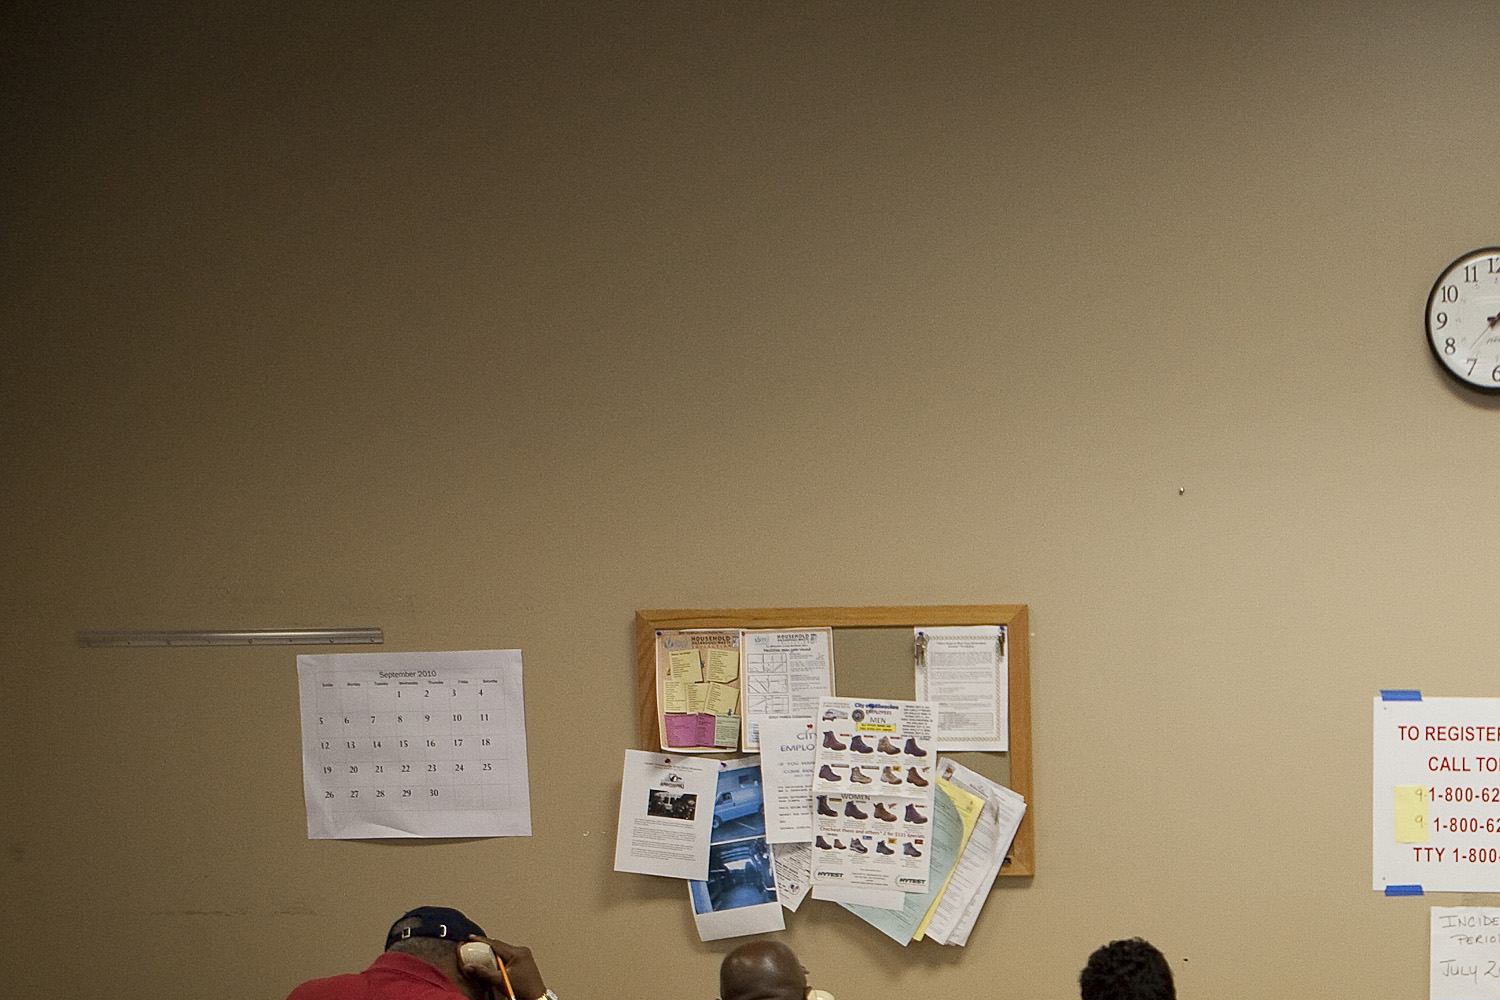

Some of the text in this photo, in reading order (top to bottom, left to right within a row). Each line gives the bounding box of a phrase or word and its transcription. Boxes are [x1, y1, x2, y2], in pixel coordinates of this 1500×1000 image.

[1464, 266, 1478, 282] 11
[1442, 285, 1458, 302] 10
[1436, 312, 1448, 330] 9
[1445, 338, 1456, 354] 8
[1466, 358, 1478, 376] 7
[379, 671, 416, 679] September
[452, 689, 457, 697] 3
[453, 714, 462, 722] 10
[1398, 726, 1419, 741] TO
[482, 763, 492, 771] 25
[1428, 757, 1471, 772] CALL
[430, 789, 439, 797] 30
[841, 793, 871, 801] WOMEN
[1413, 848, 1446, 862] TTY
